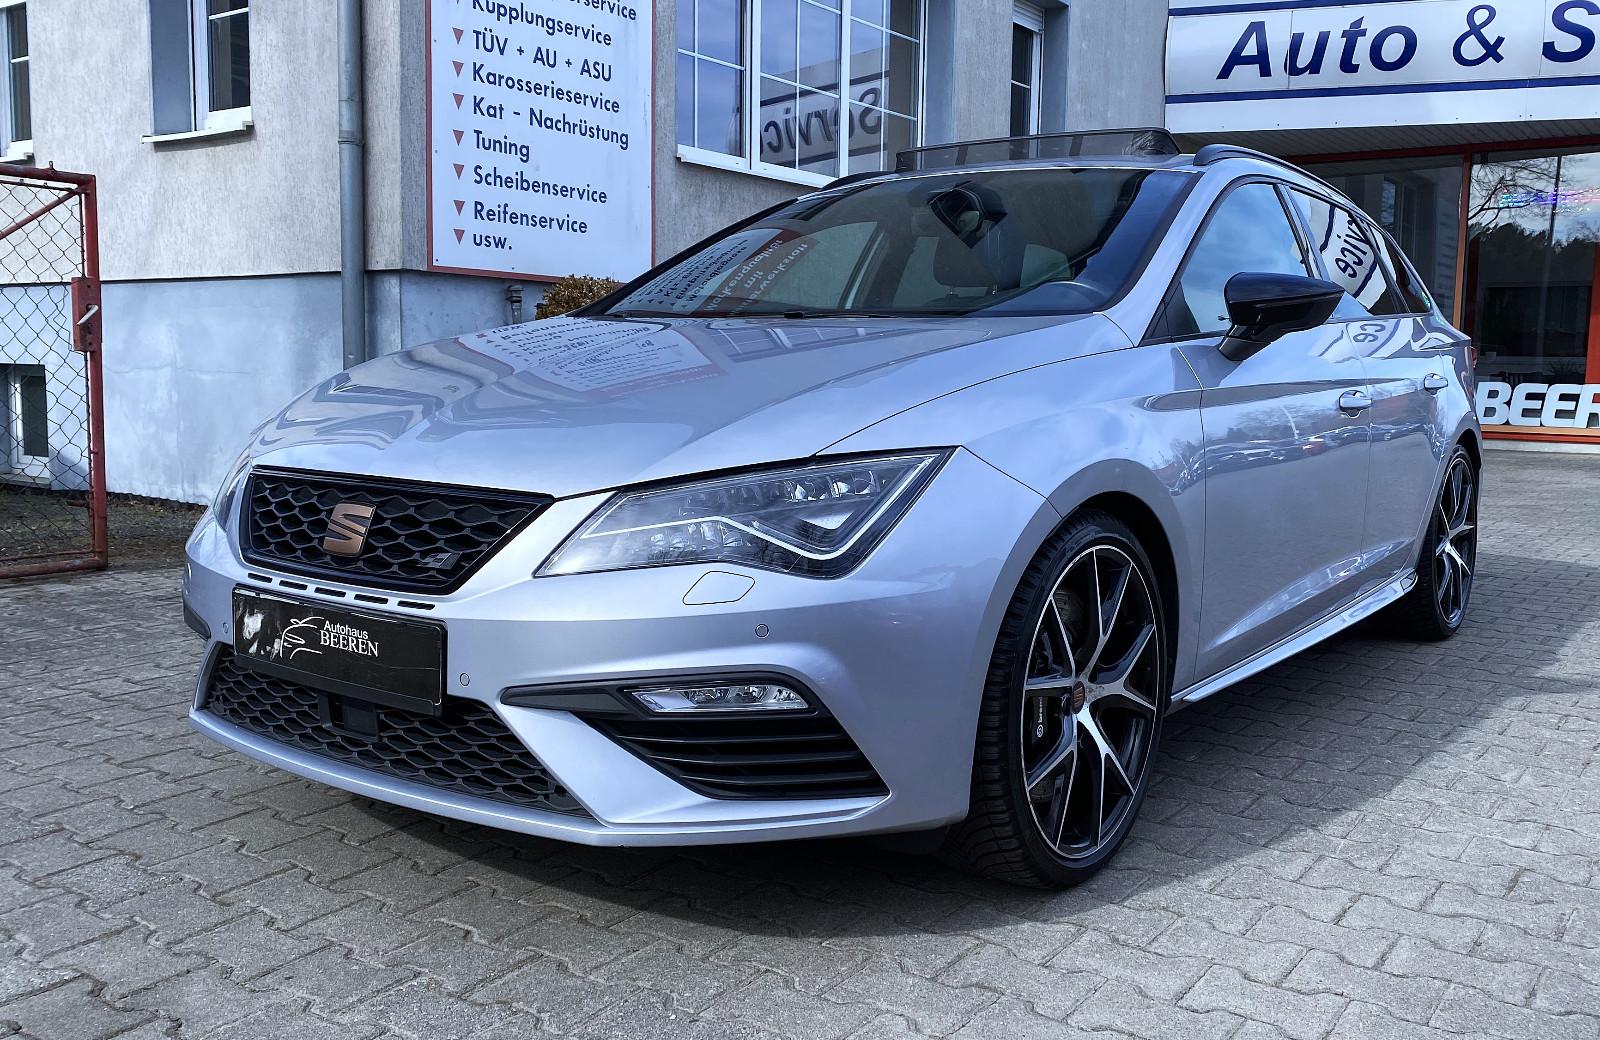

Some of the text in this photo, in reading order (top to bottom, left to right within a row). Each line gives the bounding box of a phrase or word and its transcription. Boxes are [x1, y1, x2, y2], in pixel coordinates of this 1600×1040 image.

[472, 0, 612, 46] Kupplungservice
[569, 0, 636, 21] service
[472, 27, 612, 82] TÜV + AU + ASU
[1216, 15, 1418, 80] Auto
[1453, 4, 1506, 67] &
[472, 61, 620, 113] Karosserieservice
[473, 95, 504, 120] Kat
[529, 107, 629, 150] Nachrüstung
[473, 129, 530, 163] Tuning
[473, 164, 608, 204] Scheibenservice
[473, 200, 588, 234] Reifenservice
[473, 232, 513, 250] usw.
[1475, 381, 1600, 428] BEER
[319, 629, 379, 658] BEEREN
[323, 620, 369, 640] Autohaus
